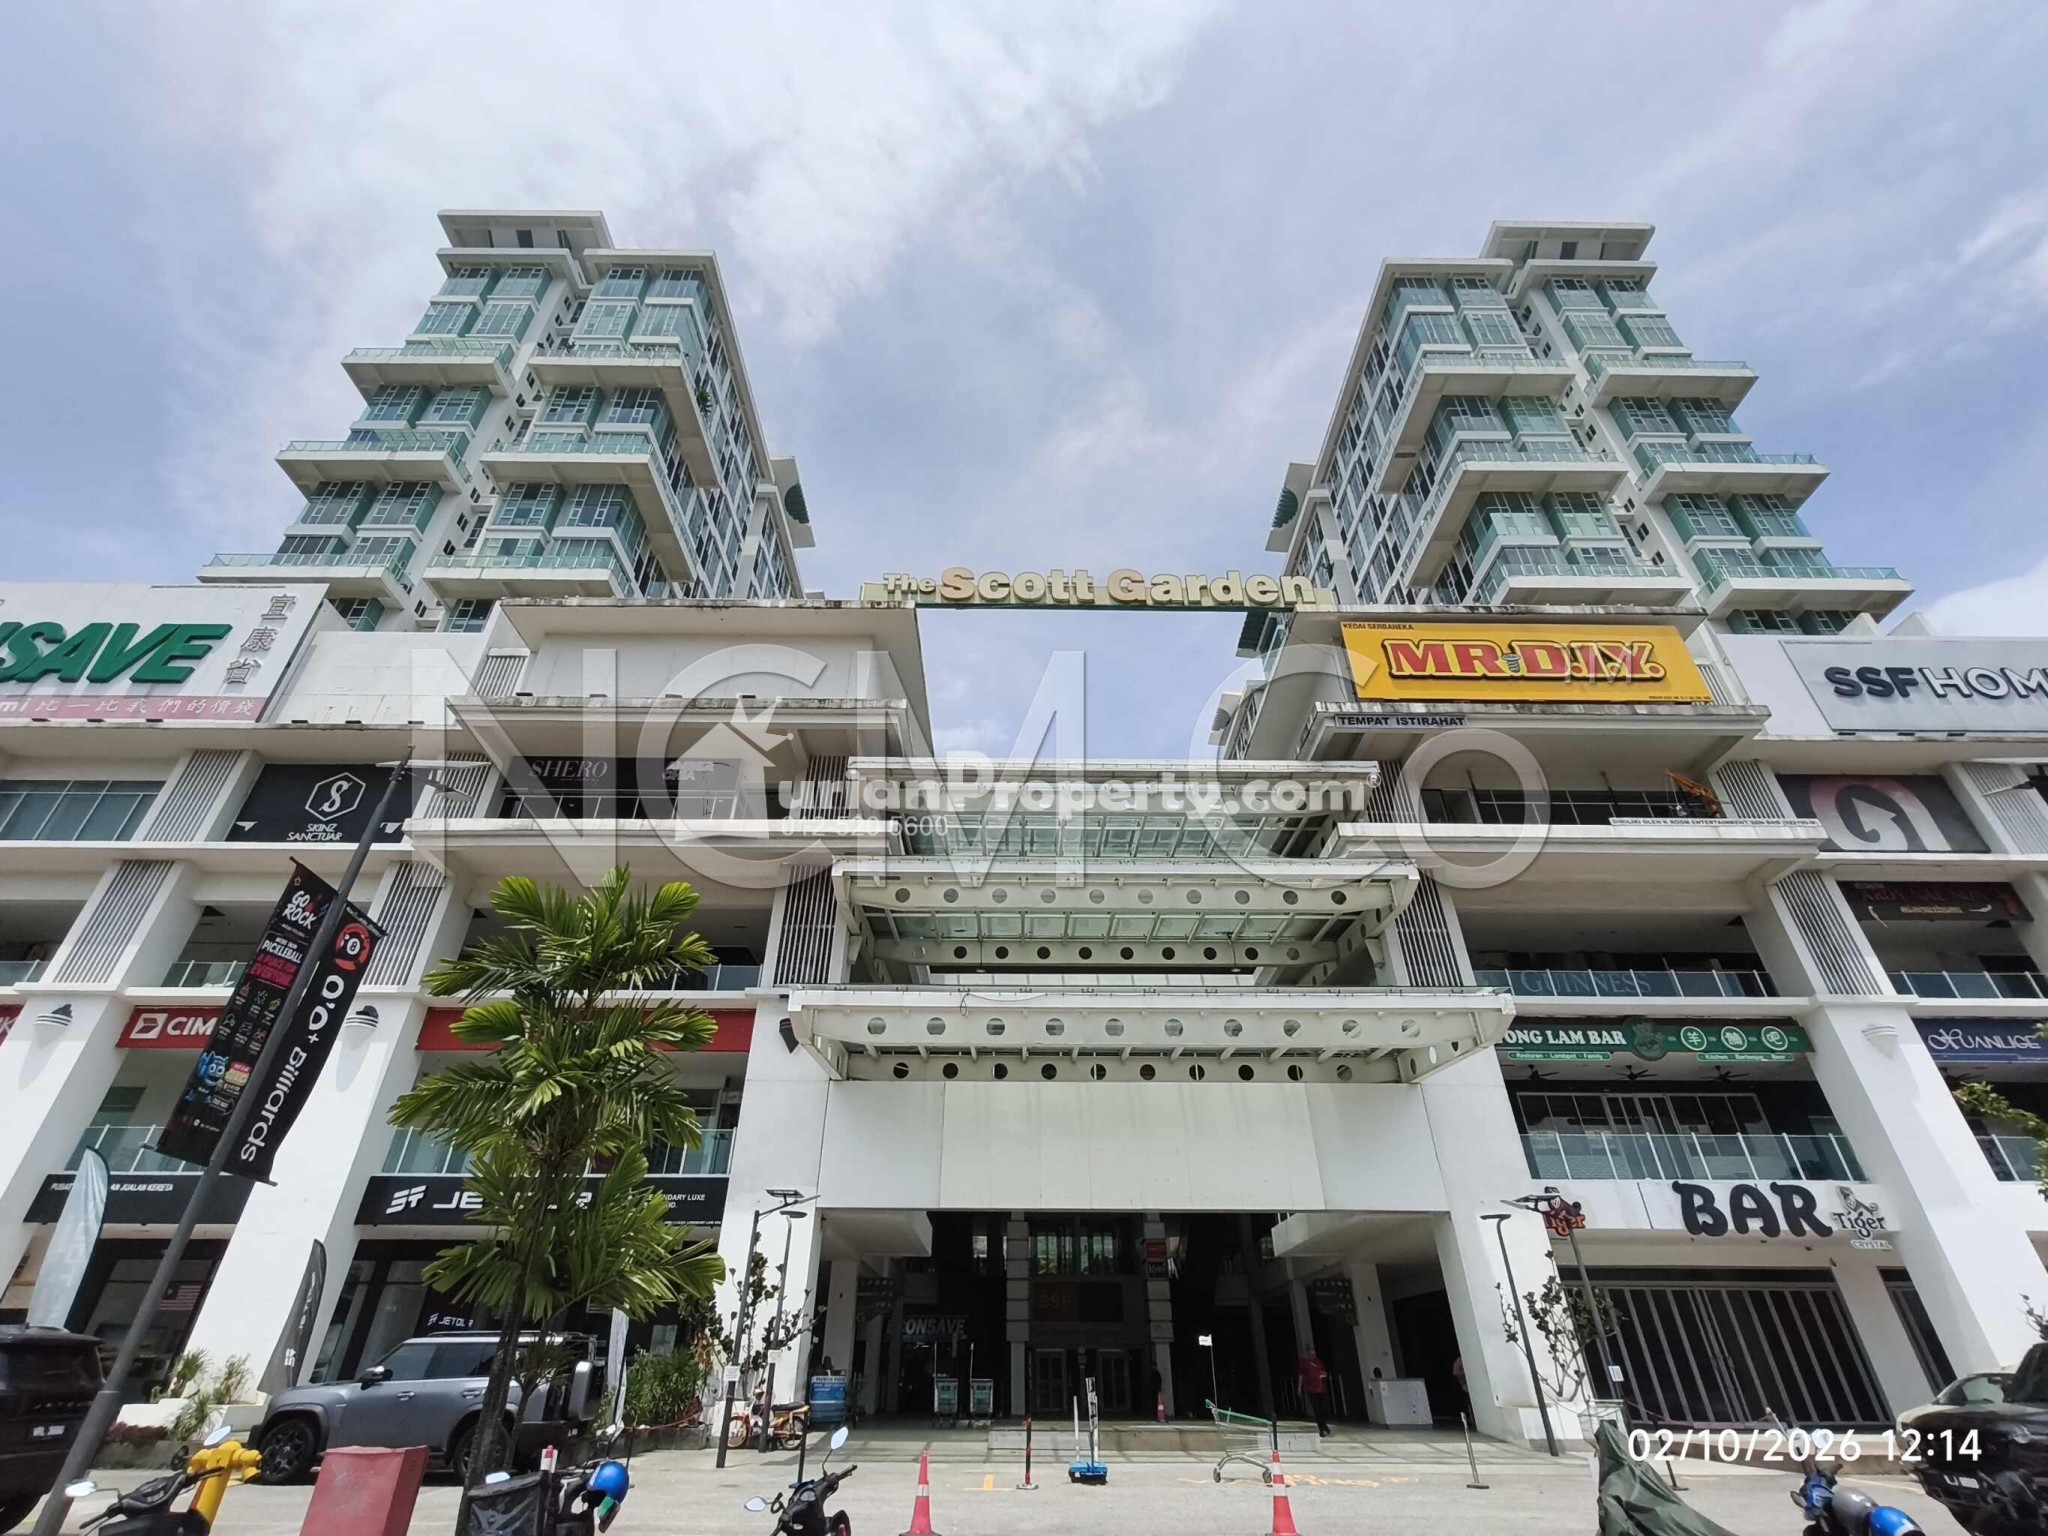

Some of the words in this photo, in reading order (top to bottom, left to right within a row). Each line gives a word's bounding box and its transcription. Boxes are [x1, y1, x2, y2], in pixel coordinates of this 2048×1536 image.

[883, 572, 936, 594] The
[941, 567, 1096, 603] Scott
[1107, 568, 1317, 605] Garden
[1343, 622, 1366, 631] KEDAI
[1367, 622, 1414, 631] SERBANEKA
[1824, 666, 1919, 698] SSF
[1340, 716, 1389, 727] TEMPAT
[1396, 716, 1465, 727] ISTIRAHAT
[529, 759, 608, 779] SHERO
[305, 823, 337, 832] SKINZ
[282, 903, 317, 930] ROCK
[262, 940, 302, 964] PICKLEBALL
[1520, 970, 1652, 994] GUINNESS
[166, 1016, 218, 1036] CIM
[1500, 1029, 1543, 1044] ONG
[1545, 1029, 1586, 1045] LAM
[1587, 1030, 1628, 1045] BAR
[240, 1046, 307, 1162] Billiards
[687, 1193, 706, 1201] LUXE
[1672, 1181, 1834, 1238] BAR
[1833, 1211, 1885, 1239] Tiger
[1852, 1240, 1892, 1249] CRYSTAL
